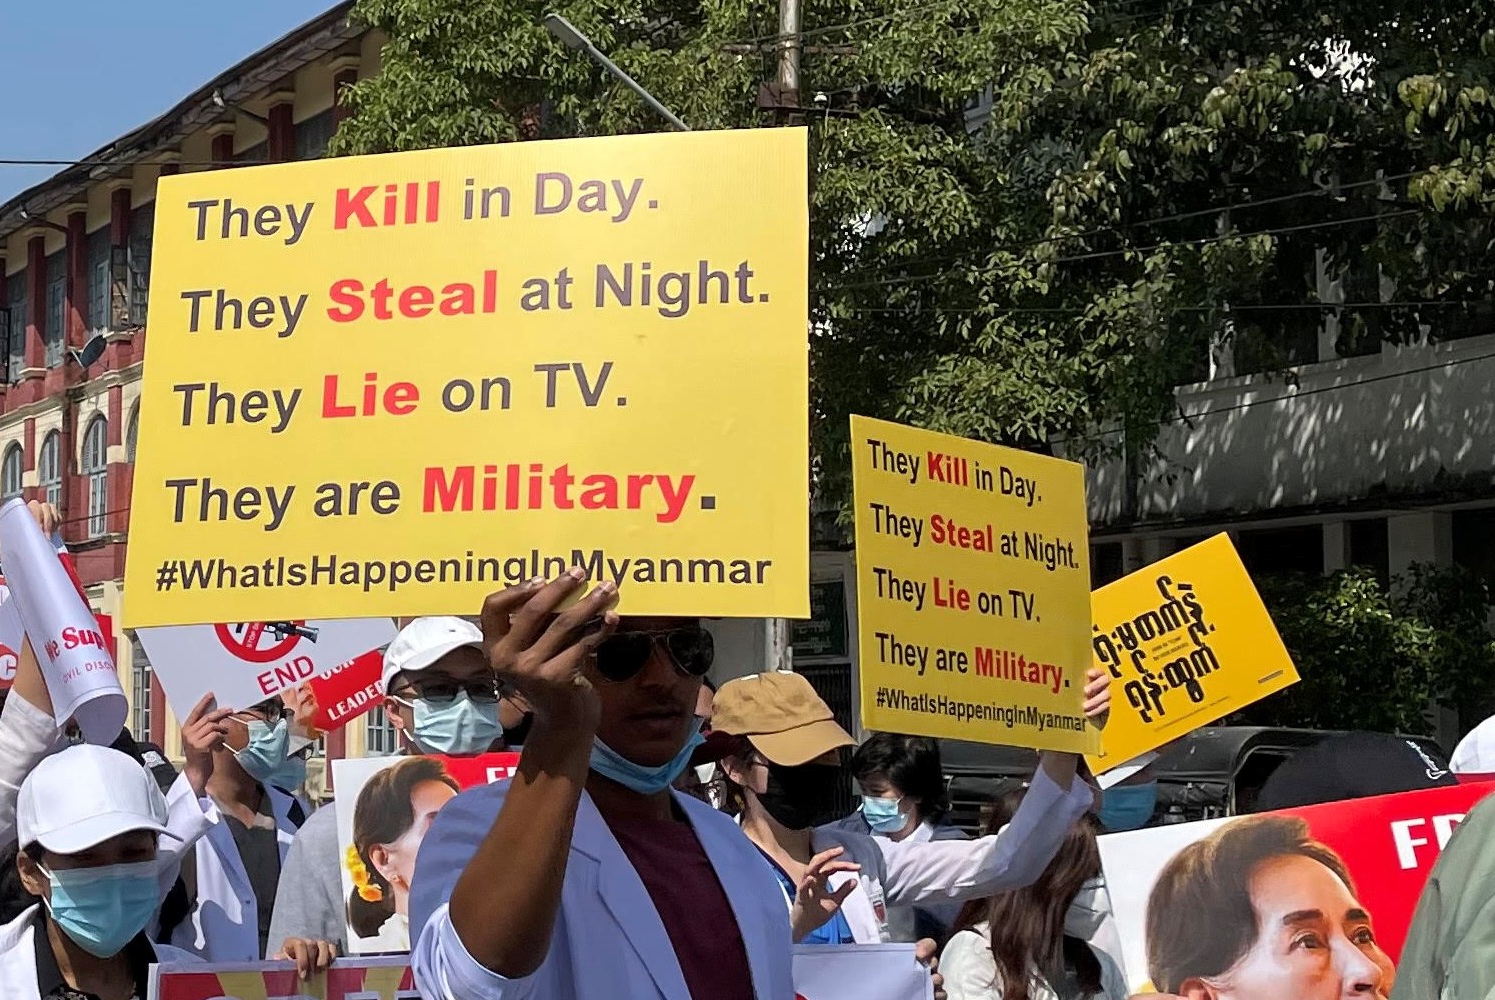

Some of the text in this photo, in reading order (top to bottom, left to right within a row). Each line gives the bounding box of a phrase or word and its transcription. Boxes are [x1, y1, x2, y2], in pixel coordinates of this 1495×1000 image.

[188, 172, 659, 245] They Kill in Day.
[181, 261, 770, 336] They Steal at Night.
[173, 361, 627, 434] They Lie on TV.
[166, 464, 716, 531] They are Military.
[867, 439, 1042, 507] They Kill in Day.
[870, 503, 1080, 571] They Steal at Night.
[156, 548, 772, 592] #WhatIsHappeningInMyanmar
[873, 567, 1041, 623] They Lie on TV.
[62, 627, 104, 650] Sup
[875, 632, 1070, 695] They are Military.
[257, 655, 315, 696] END
[876, 687, 1087, 732] #WhatIsHappeningInMyanmar
